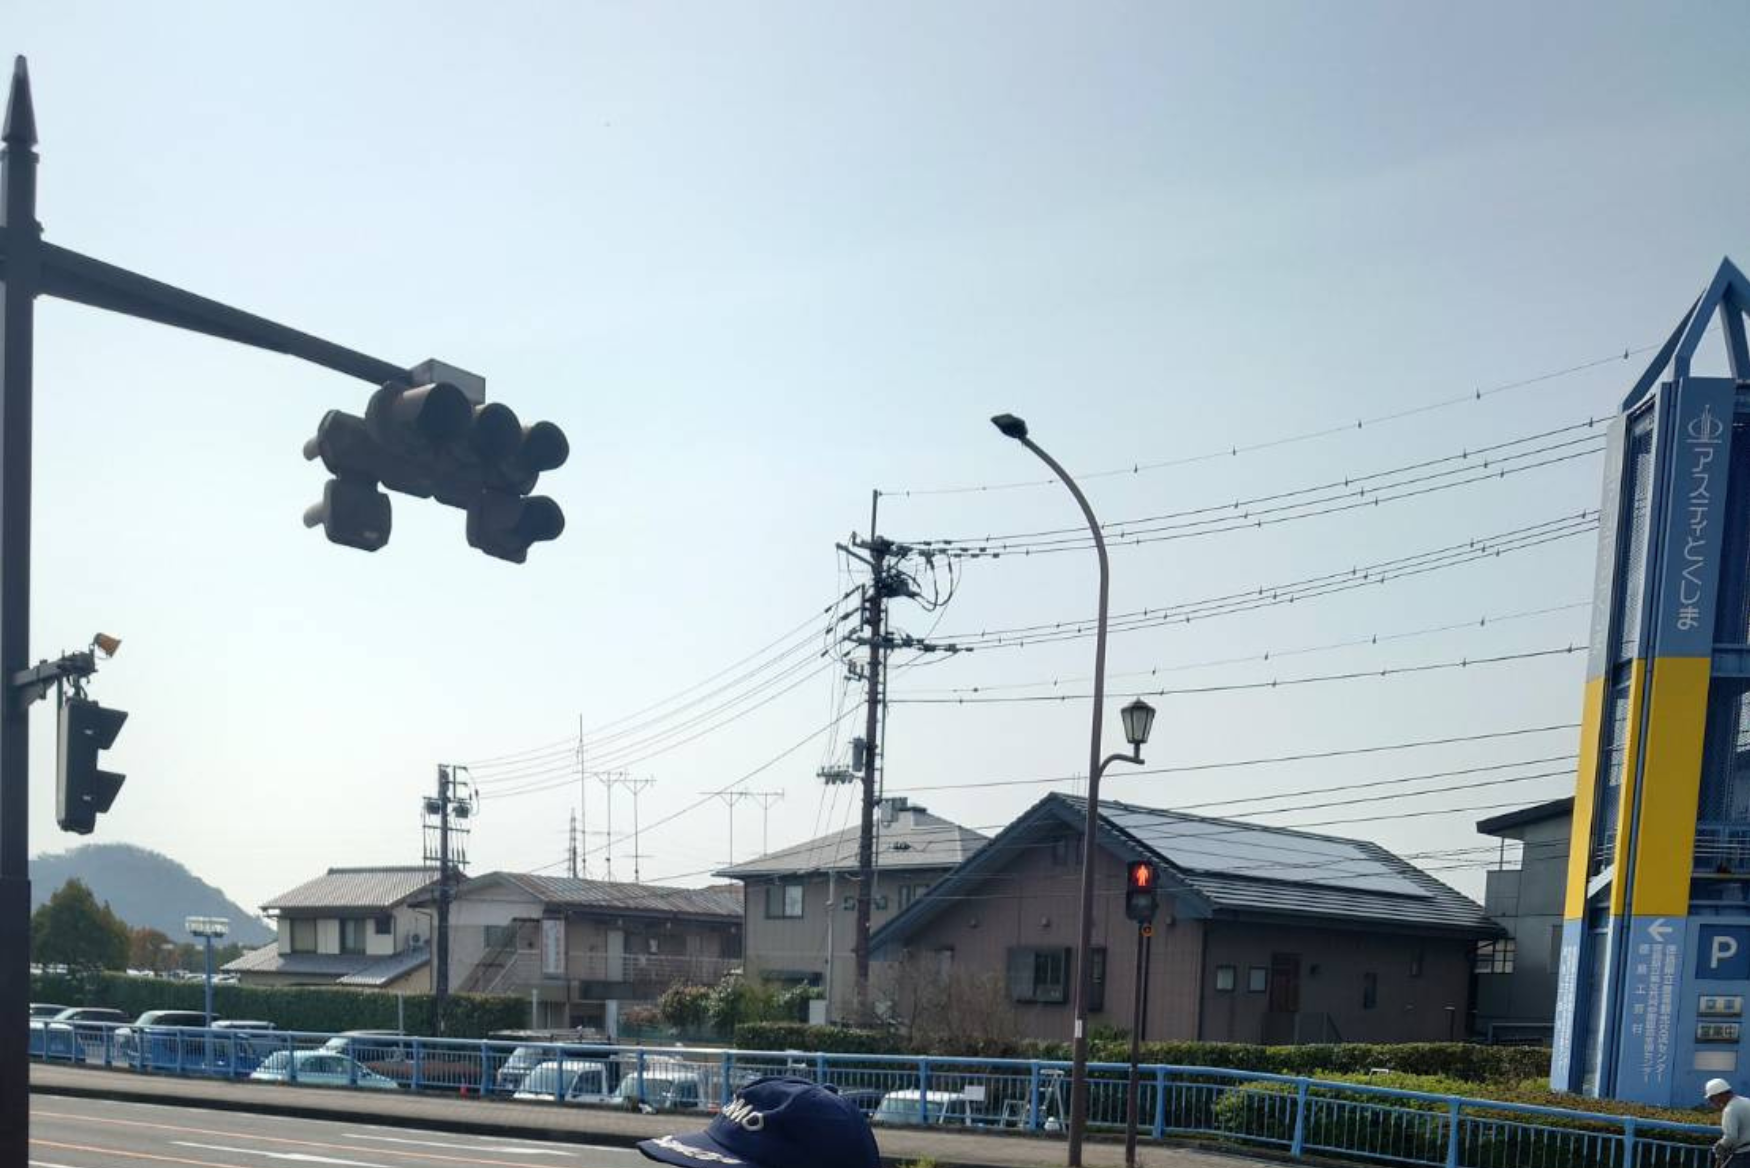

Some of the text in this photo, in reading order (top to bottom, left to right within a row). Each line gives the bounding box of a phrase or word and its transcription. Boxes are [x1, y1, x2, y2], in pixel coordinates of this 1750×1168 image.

[1676, 447, 1714, 631] アスティとくしま
[1709, 935, 1738, 969] P
